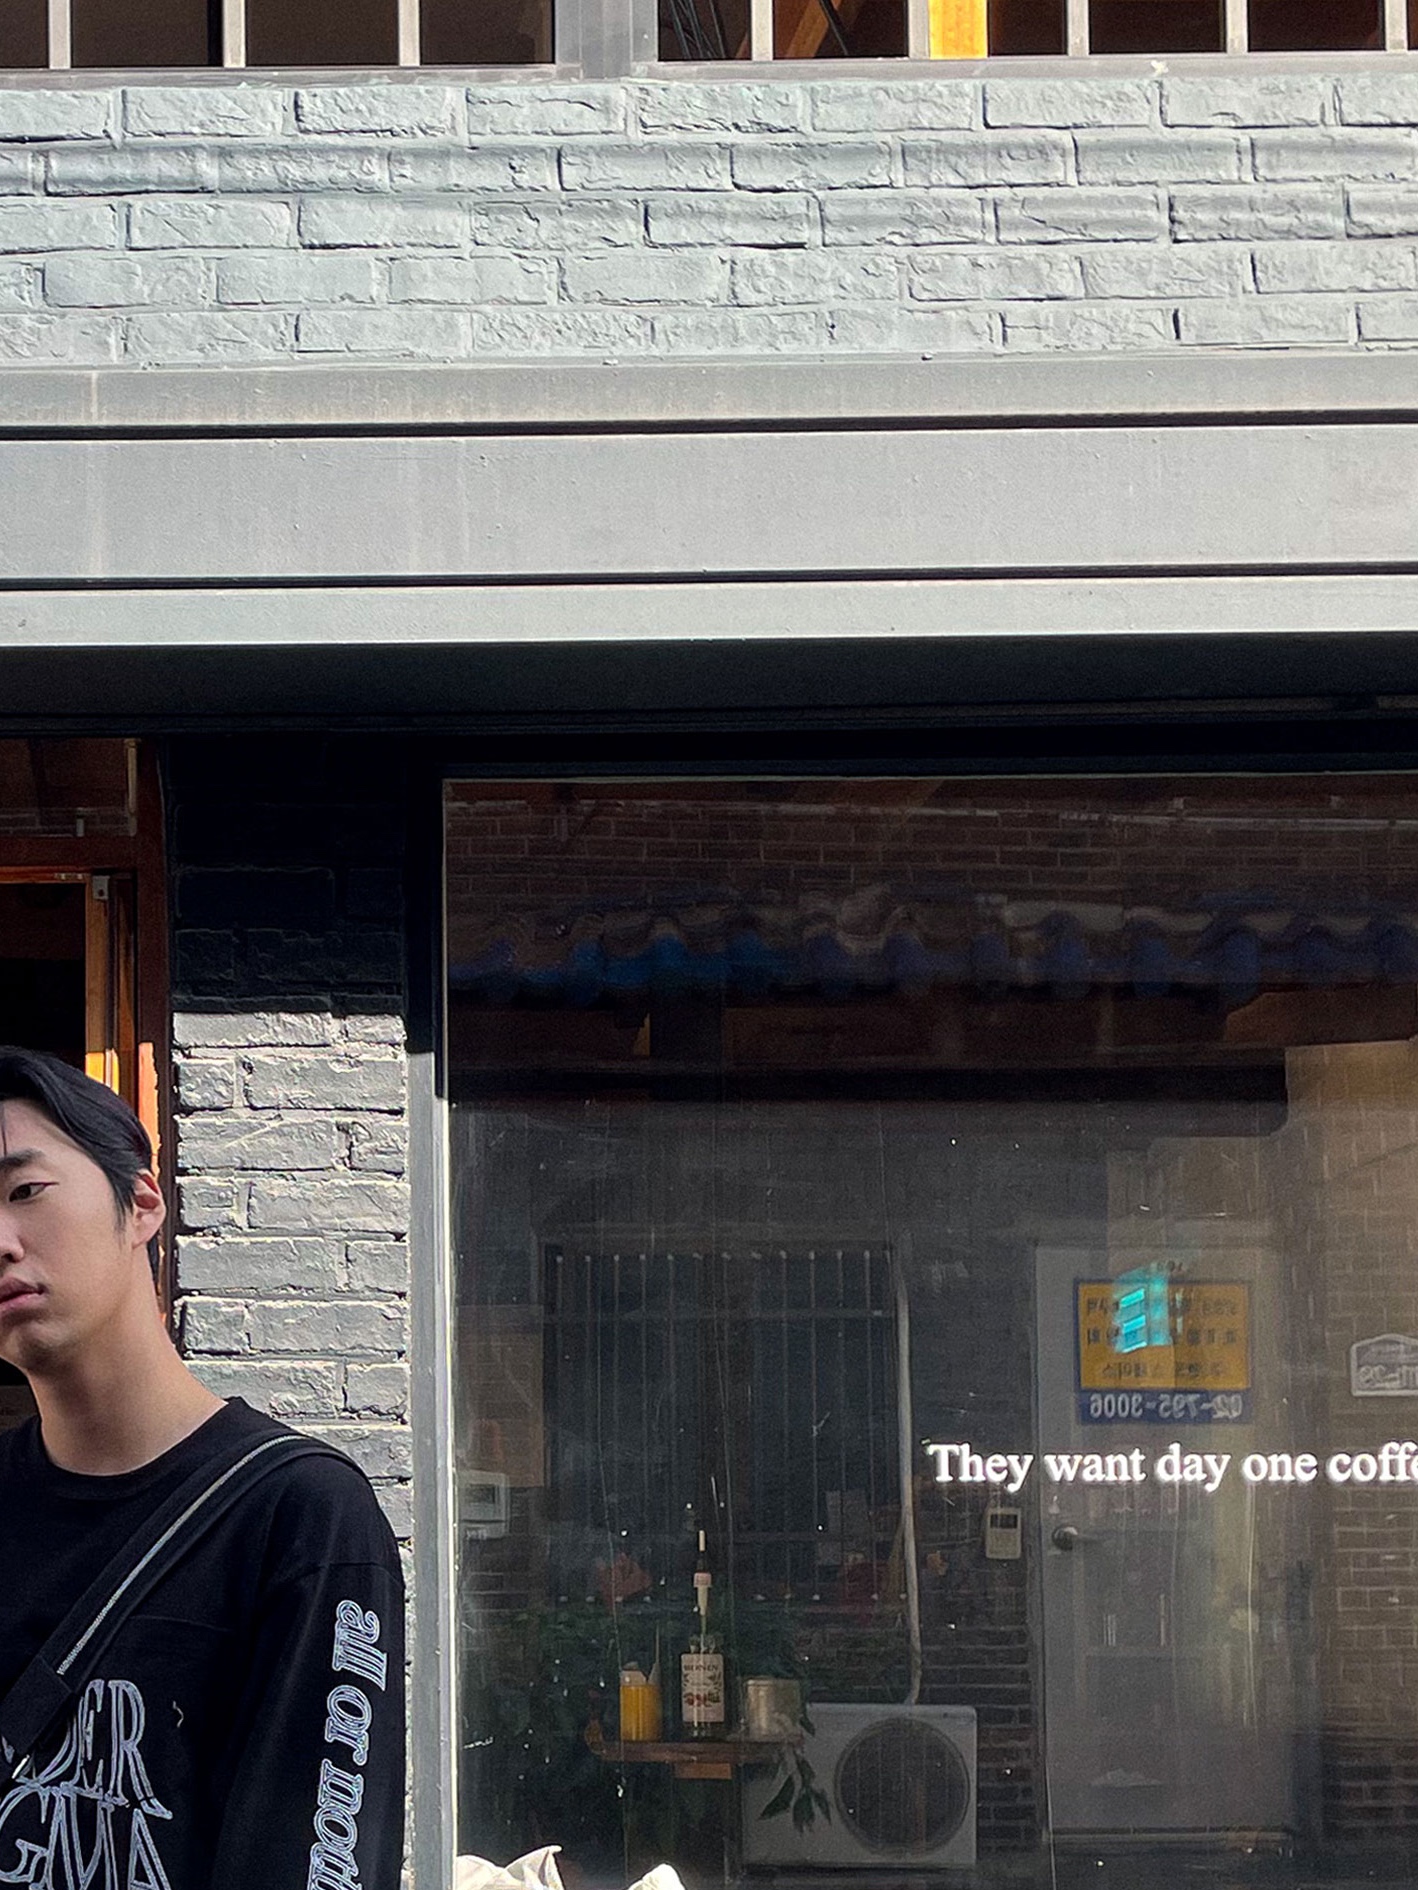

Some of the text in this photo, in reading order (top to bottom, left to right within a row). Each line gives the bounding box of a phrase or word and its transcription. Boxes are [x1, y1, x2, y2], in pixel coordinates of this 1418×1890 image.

[928, 1442, 1034, 1493] They
[1044, 1447, 1146, 1483] want
[1156, 1443, 1231, 1491] day
[1243, 1452, 1317, 1483] one
[333, 1598, 388, 1691] all
[322, 1684, 374, 1766] or
